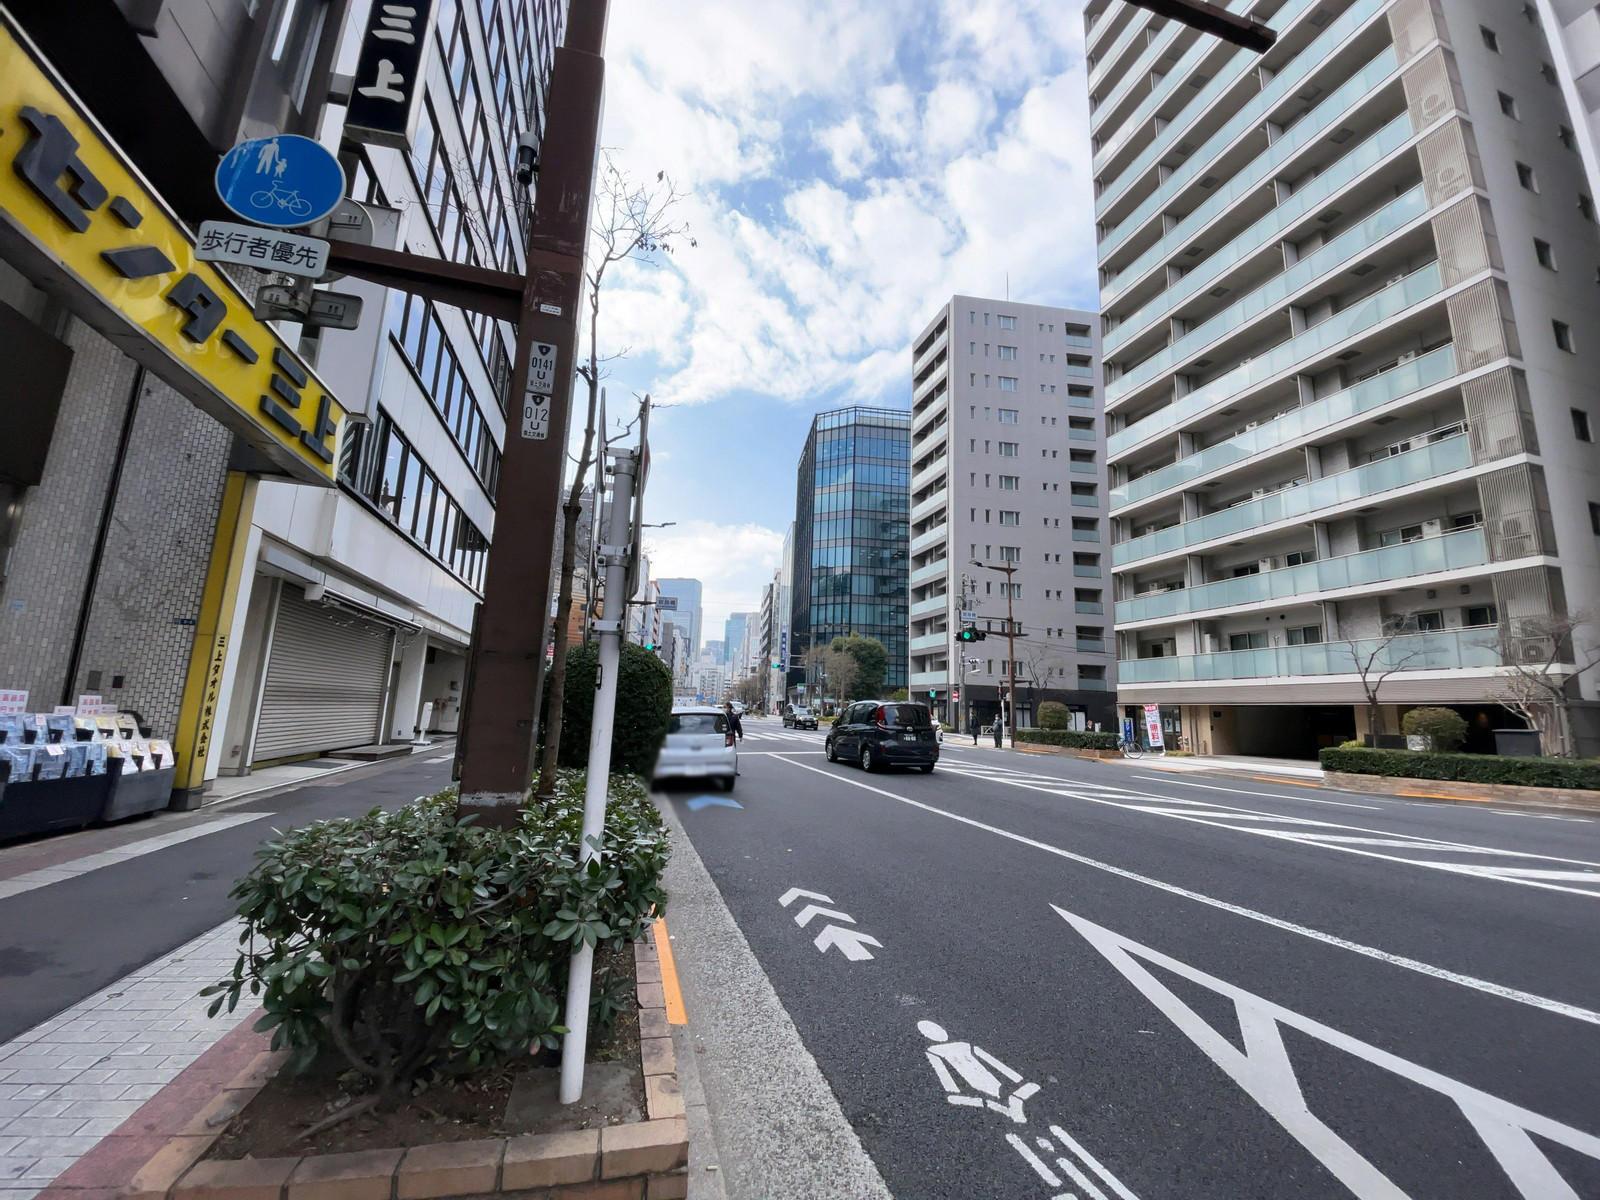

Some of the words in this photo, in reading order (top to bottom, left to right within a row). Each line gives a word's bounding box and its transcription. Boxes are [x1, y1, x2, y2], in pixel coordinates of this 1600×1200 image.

[357, 4, 417, 104] 三上
[201, 228, 319, 270] 歩行者優先
[531, 356, 553, 371] 0141
[536, 370, 546, 380] U
[524, 406, 548, 422] 012
[530, 421, 540, 431] U
[197, 636, 226, 758] 三上タオル株式会社
